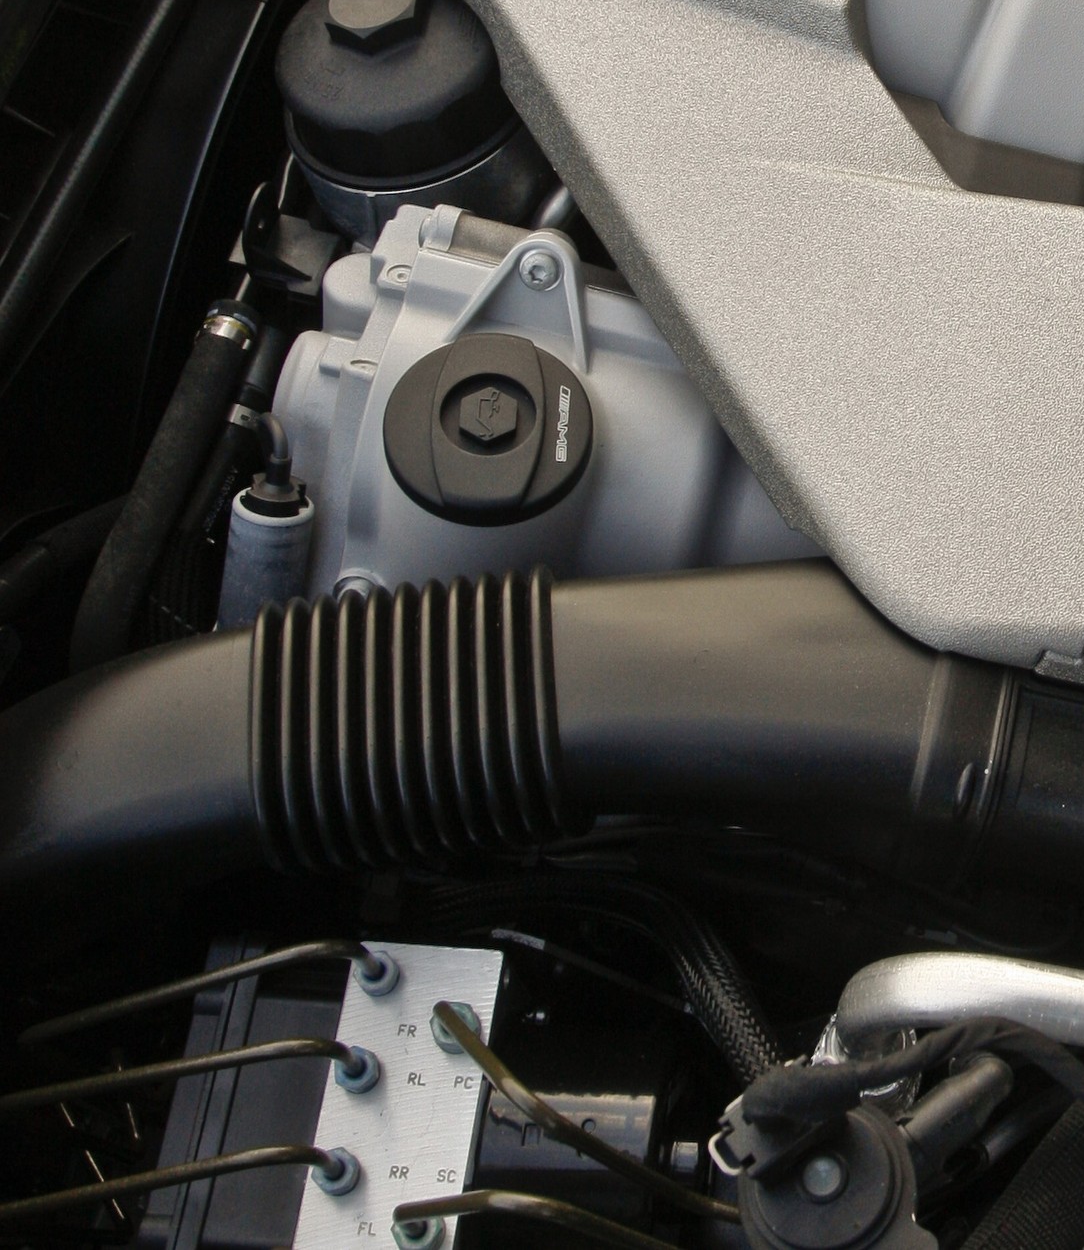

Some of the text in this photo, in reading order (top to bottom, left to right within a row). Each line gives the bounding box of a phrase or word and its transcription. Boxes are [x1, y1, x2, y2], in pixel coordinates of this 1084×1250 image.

[396, 1023, 418, 1038] FR
[407, 1071, 426, 1087] RL
[453, 1075, 475, 1090] PC
[388, 1165, 410, 1180] RR
[436, 1168, 457, 1184] SC
[357, 1221, 376, 1237] FL
